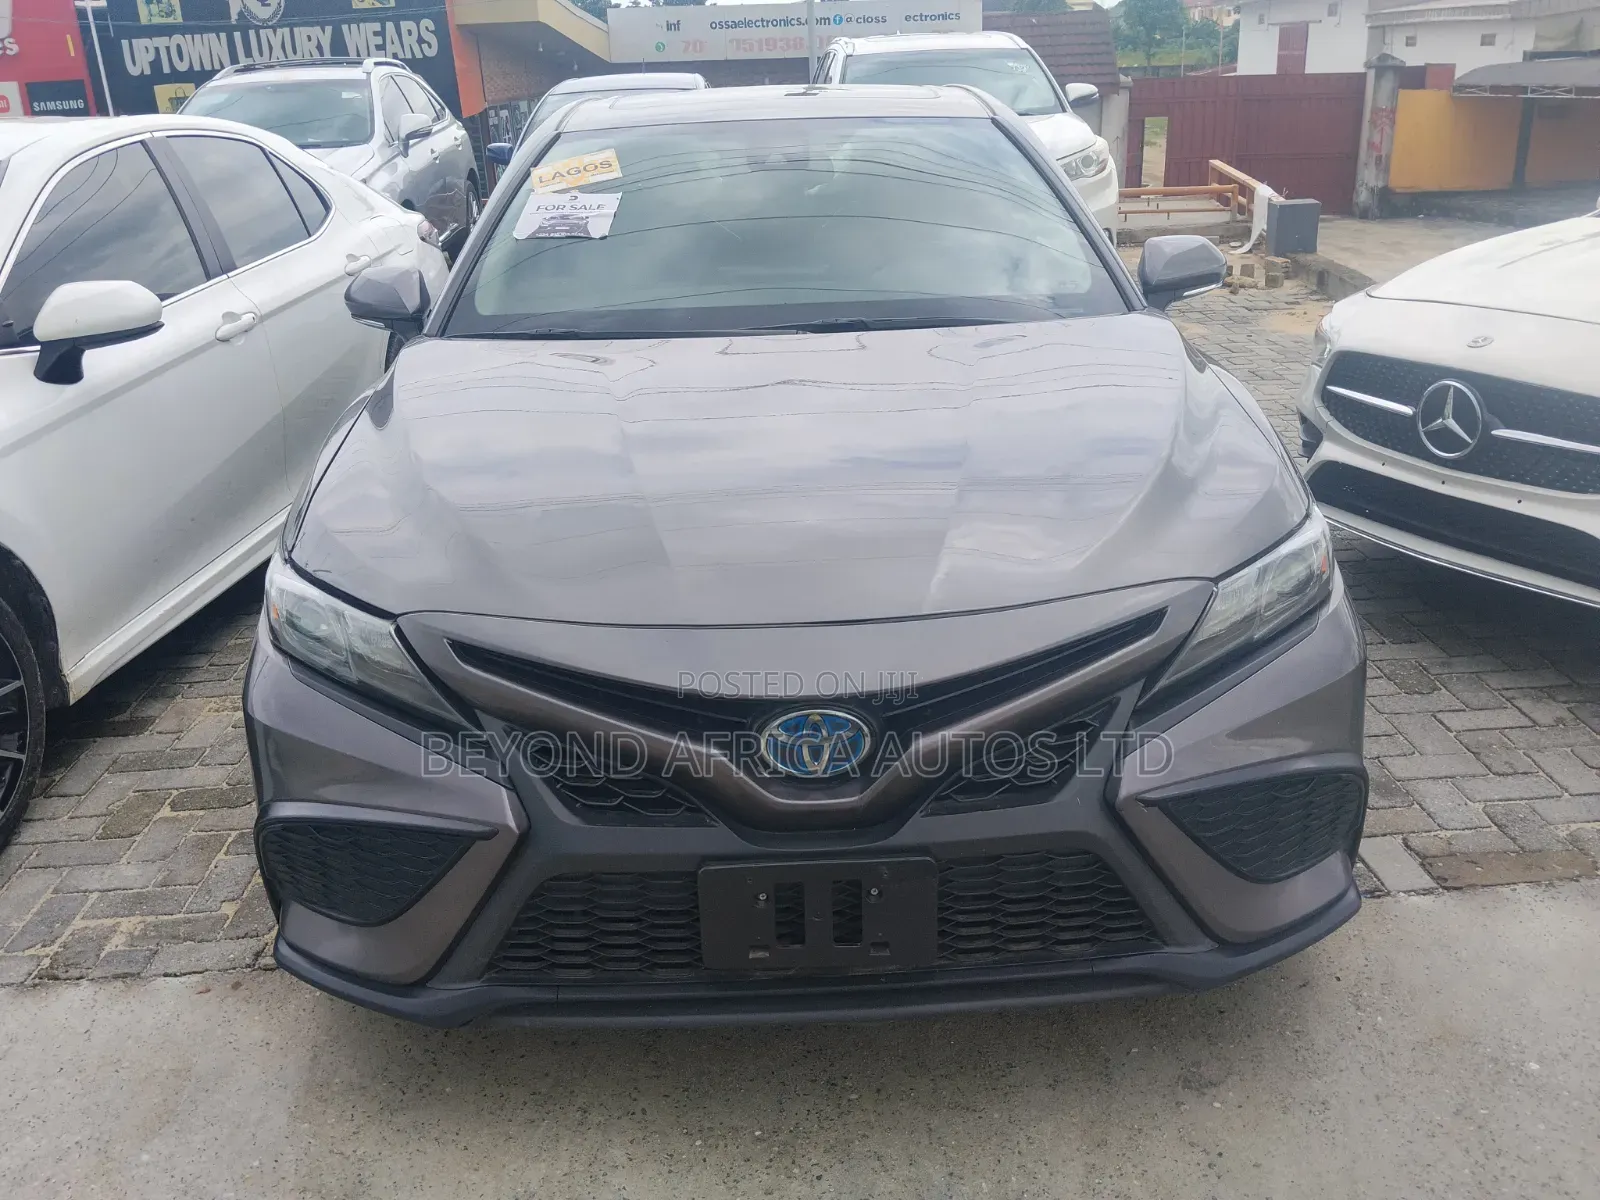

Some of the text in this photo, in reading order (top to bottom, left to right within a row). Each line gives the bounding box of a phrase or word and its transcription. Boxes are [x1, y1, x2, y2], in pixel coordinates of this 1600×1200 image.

[121, 18, 439, 76] UPTOWN LUXURY WEARS
[33, 99, 84, 112] SAMSUNG
[538, 160, 613, 184] LAGOS
[536, 203, 606, 212] FOR SALE
